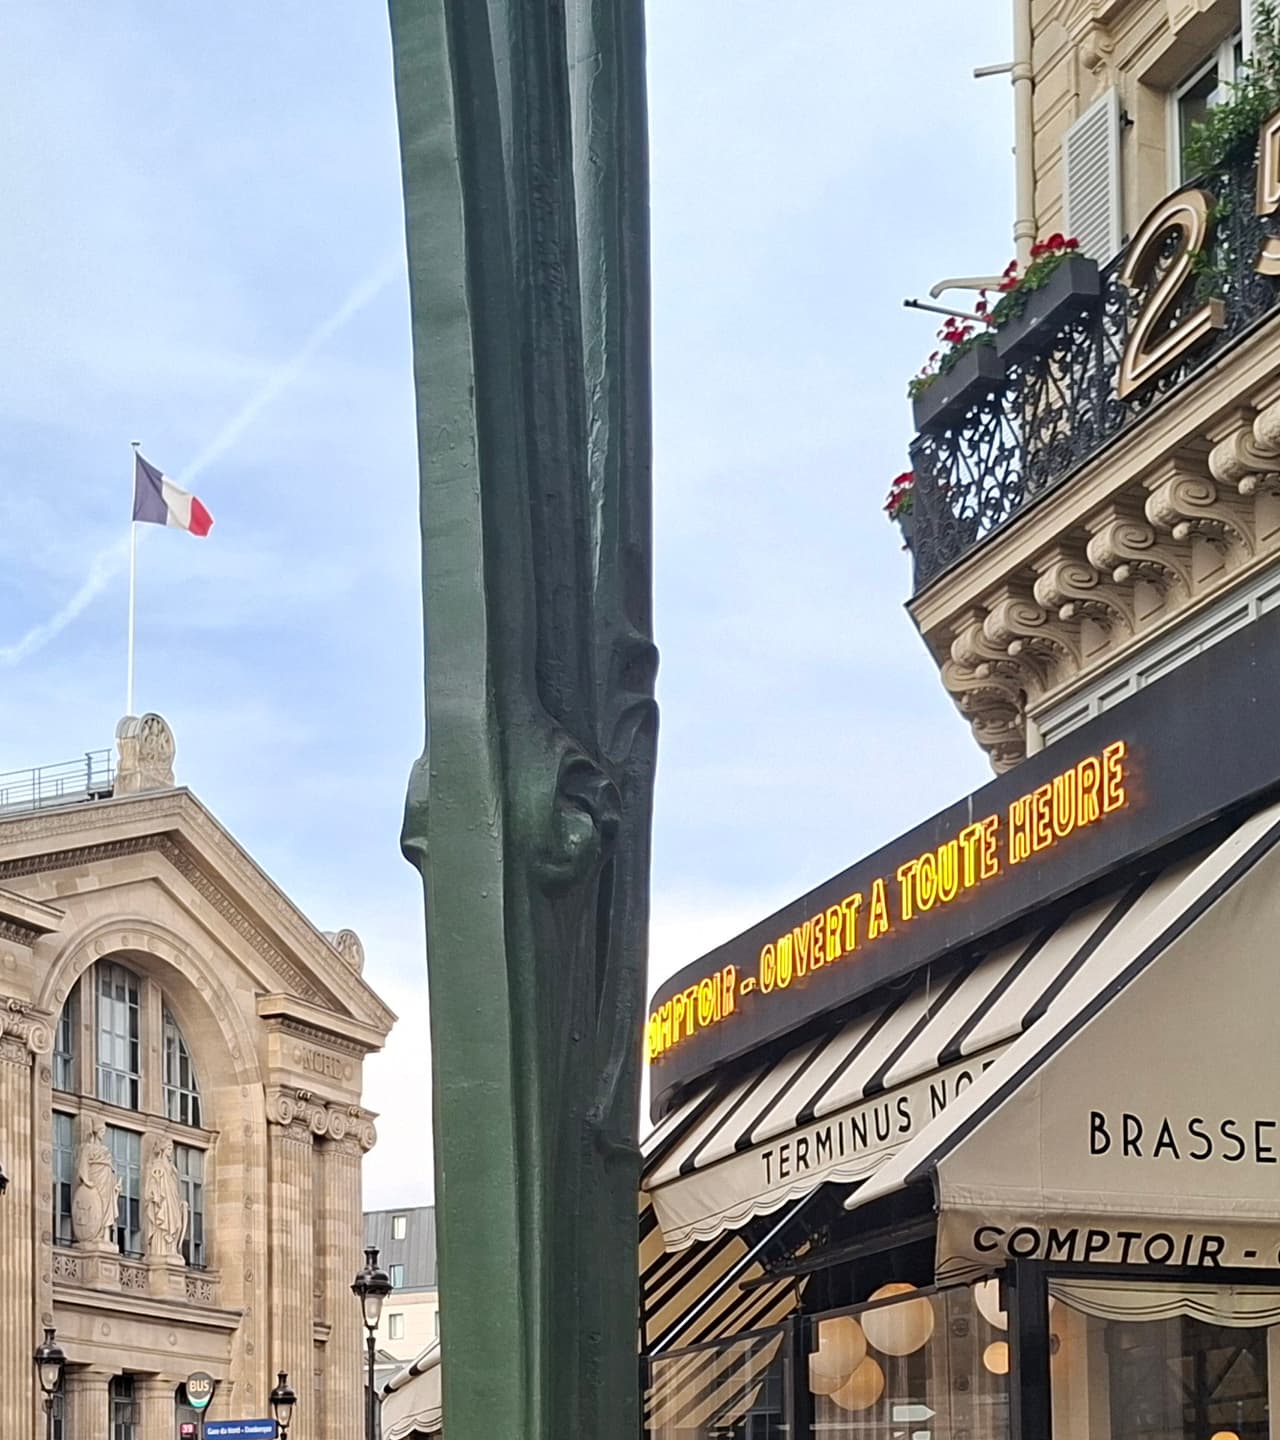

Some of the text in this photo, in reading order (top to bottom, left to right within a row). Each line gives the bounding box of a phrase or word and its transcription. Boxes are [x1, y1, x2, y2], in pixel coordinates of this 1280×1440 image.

[760, 892, 863, 994] OUVERT
[869, 878, 888, 939] A
[897, 814, 999, 921] TOUTE
[1008, 740, 1125, 864] HEURE
[762, 1096, 911, 1185] TERMINUS
[973, 1226, 1226, 1267] COMPTOIR
[189, 1379, 210, 1392] BUS
